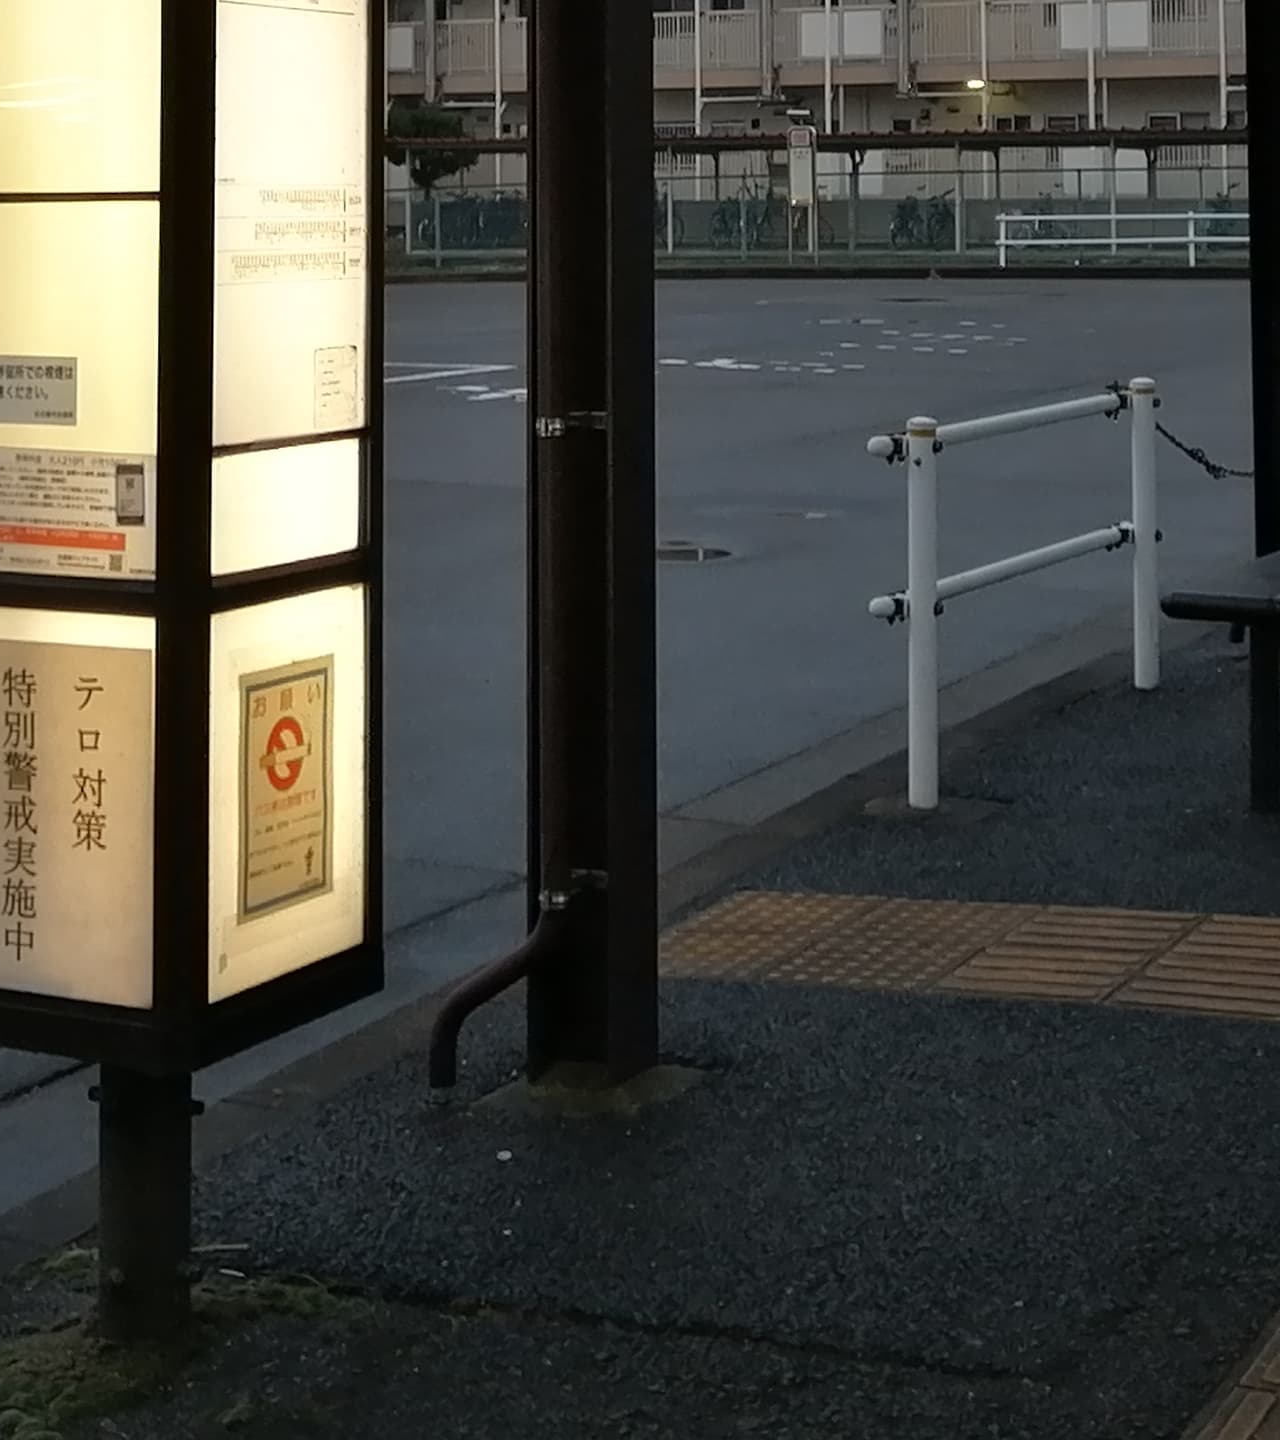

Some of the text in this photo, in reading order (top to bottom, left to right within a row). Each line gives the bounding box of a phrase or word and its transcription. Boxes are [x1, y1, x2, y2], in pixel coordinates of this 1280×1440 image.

[1, 666, 39, 962] 特別警戒実施中
[72, 676, 107, 851] テロ対策
